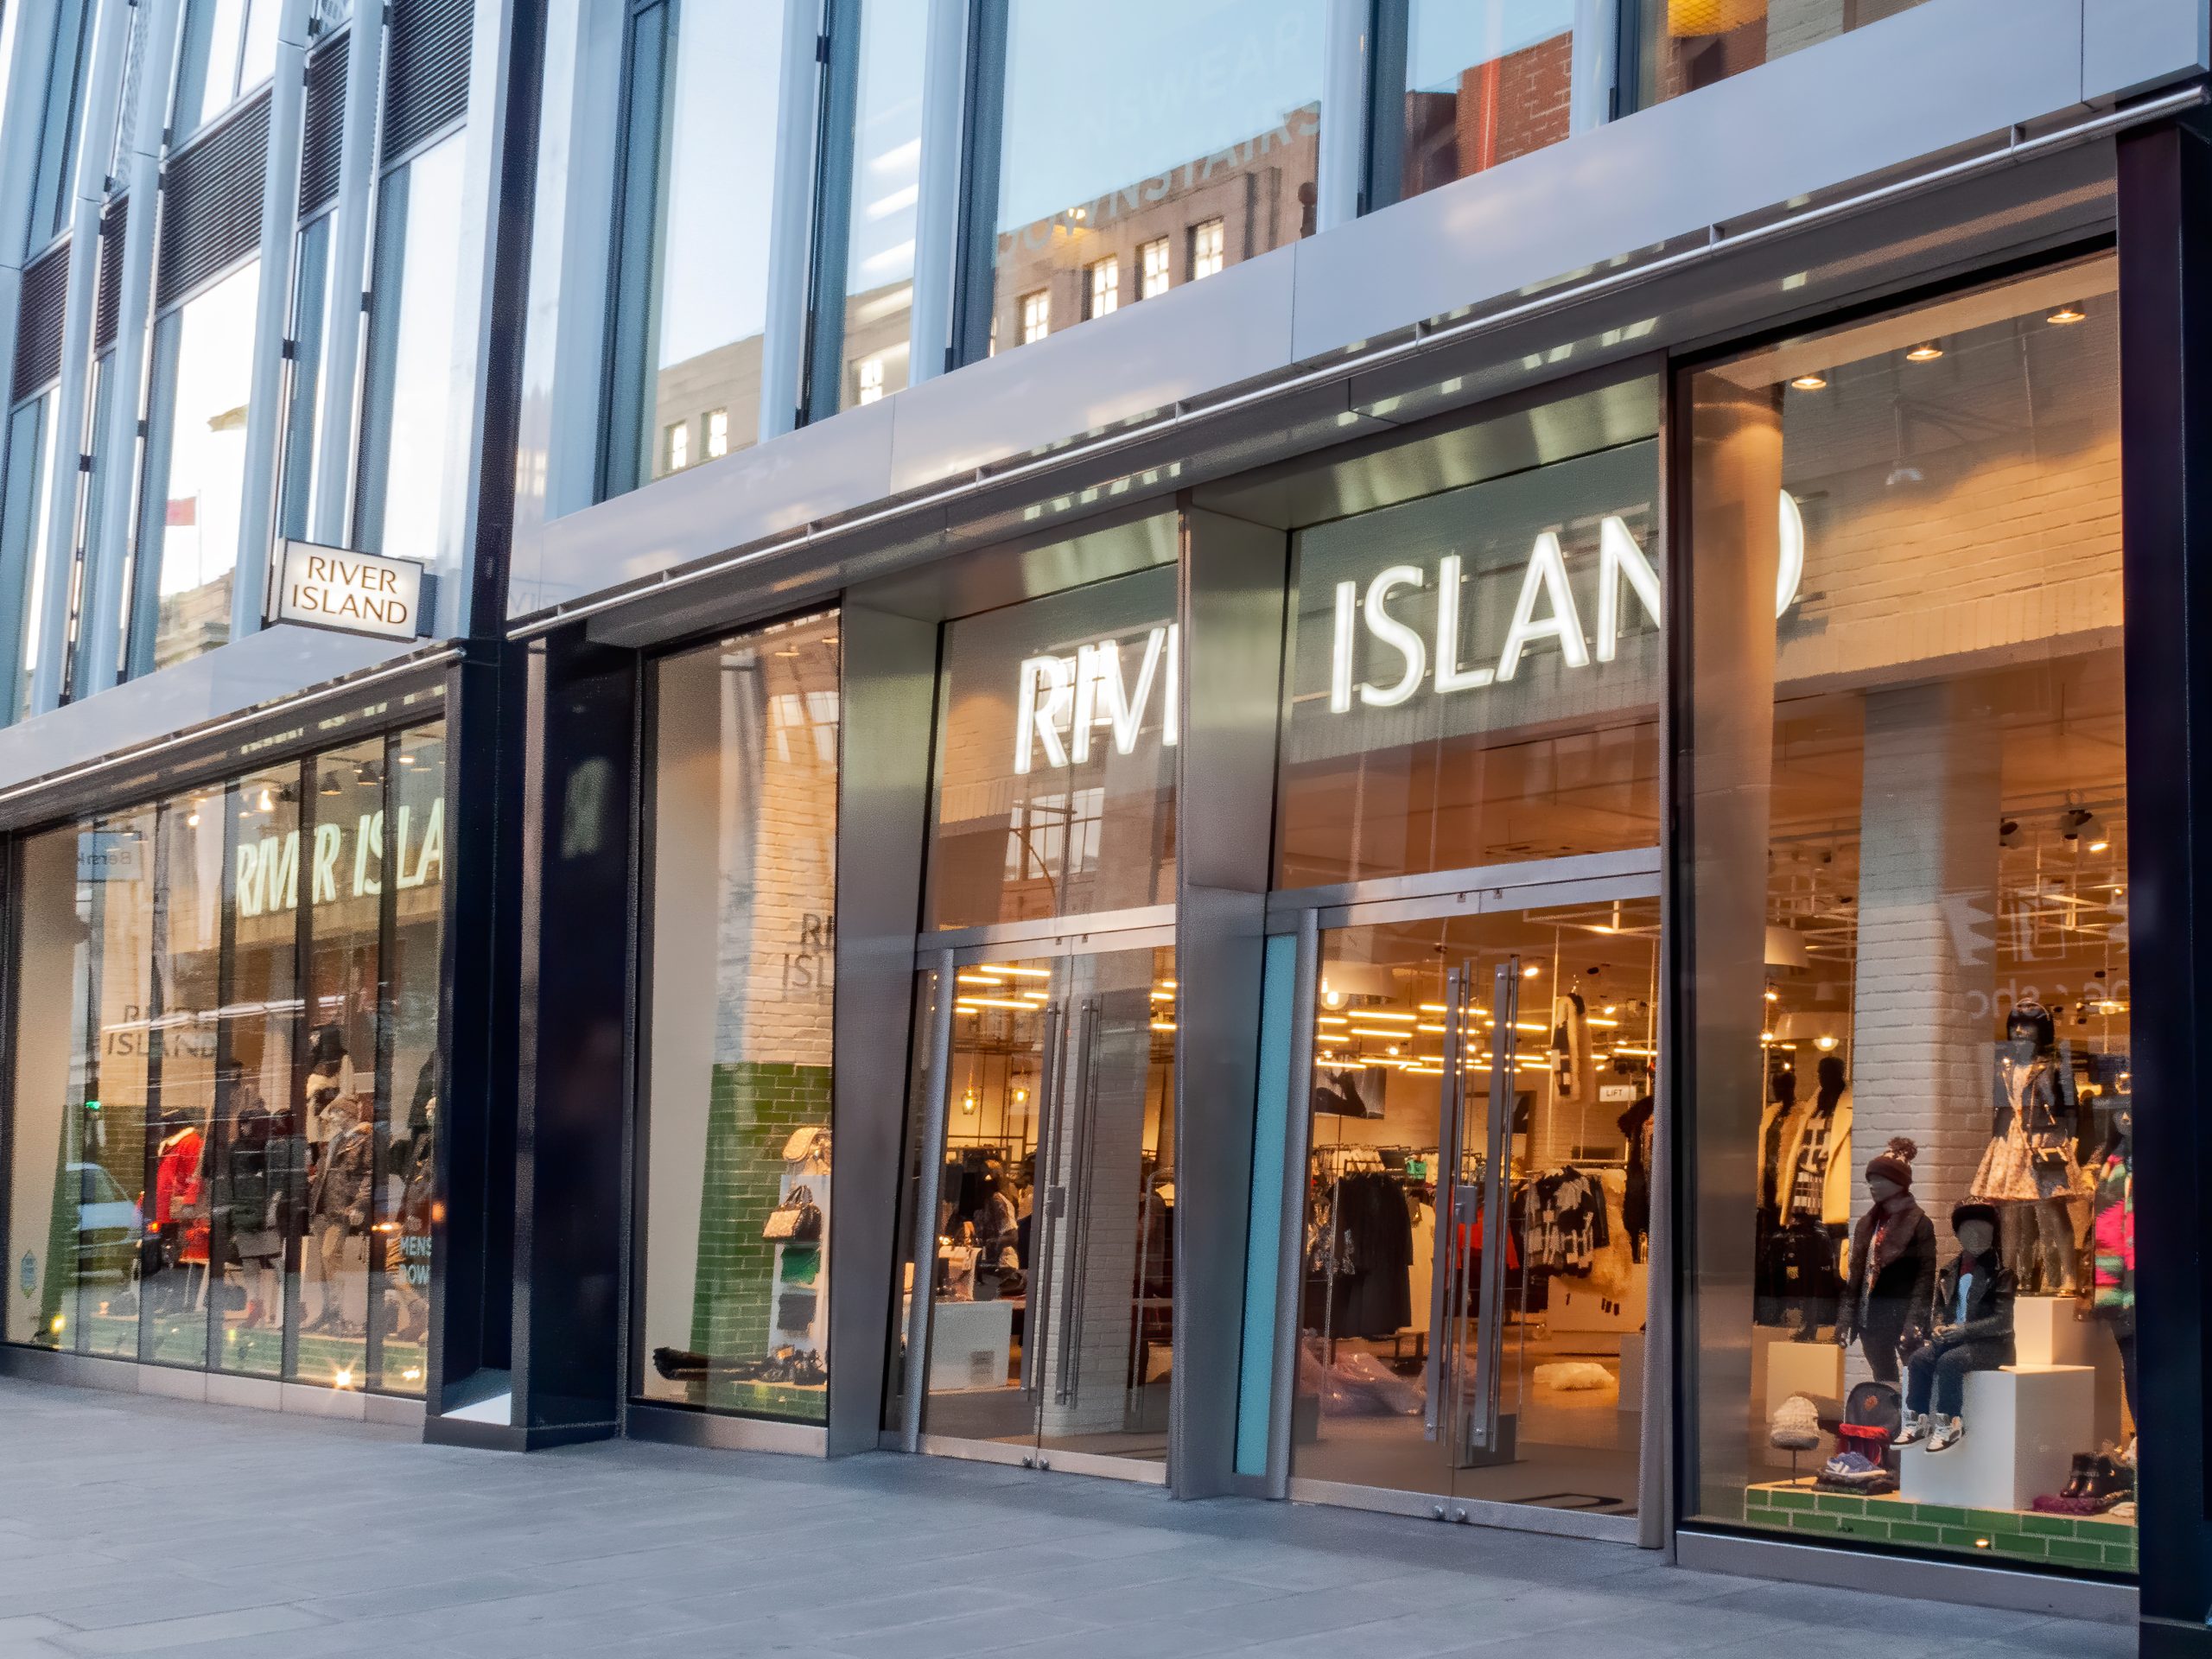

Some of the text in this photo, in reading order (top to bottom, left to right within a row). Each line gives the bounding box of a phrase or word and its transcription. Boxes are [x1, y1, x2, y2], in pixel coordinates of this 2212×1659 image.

[308, 556, 397, 594] RIVER
[291, 583, 408, 625] ISLAND
[1014, 623, 1179, 774] RIV
[353, 798, 445, 898] ISLA
[782, 954, 834, 989] ISL
[1606, 1089, 1624, 1097] LIFT
[400, 1236, 432, 1256] MENS
[398, 1263, 430, 1285] DOW
